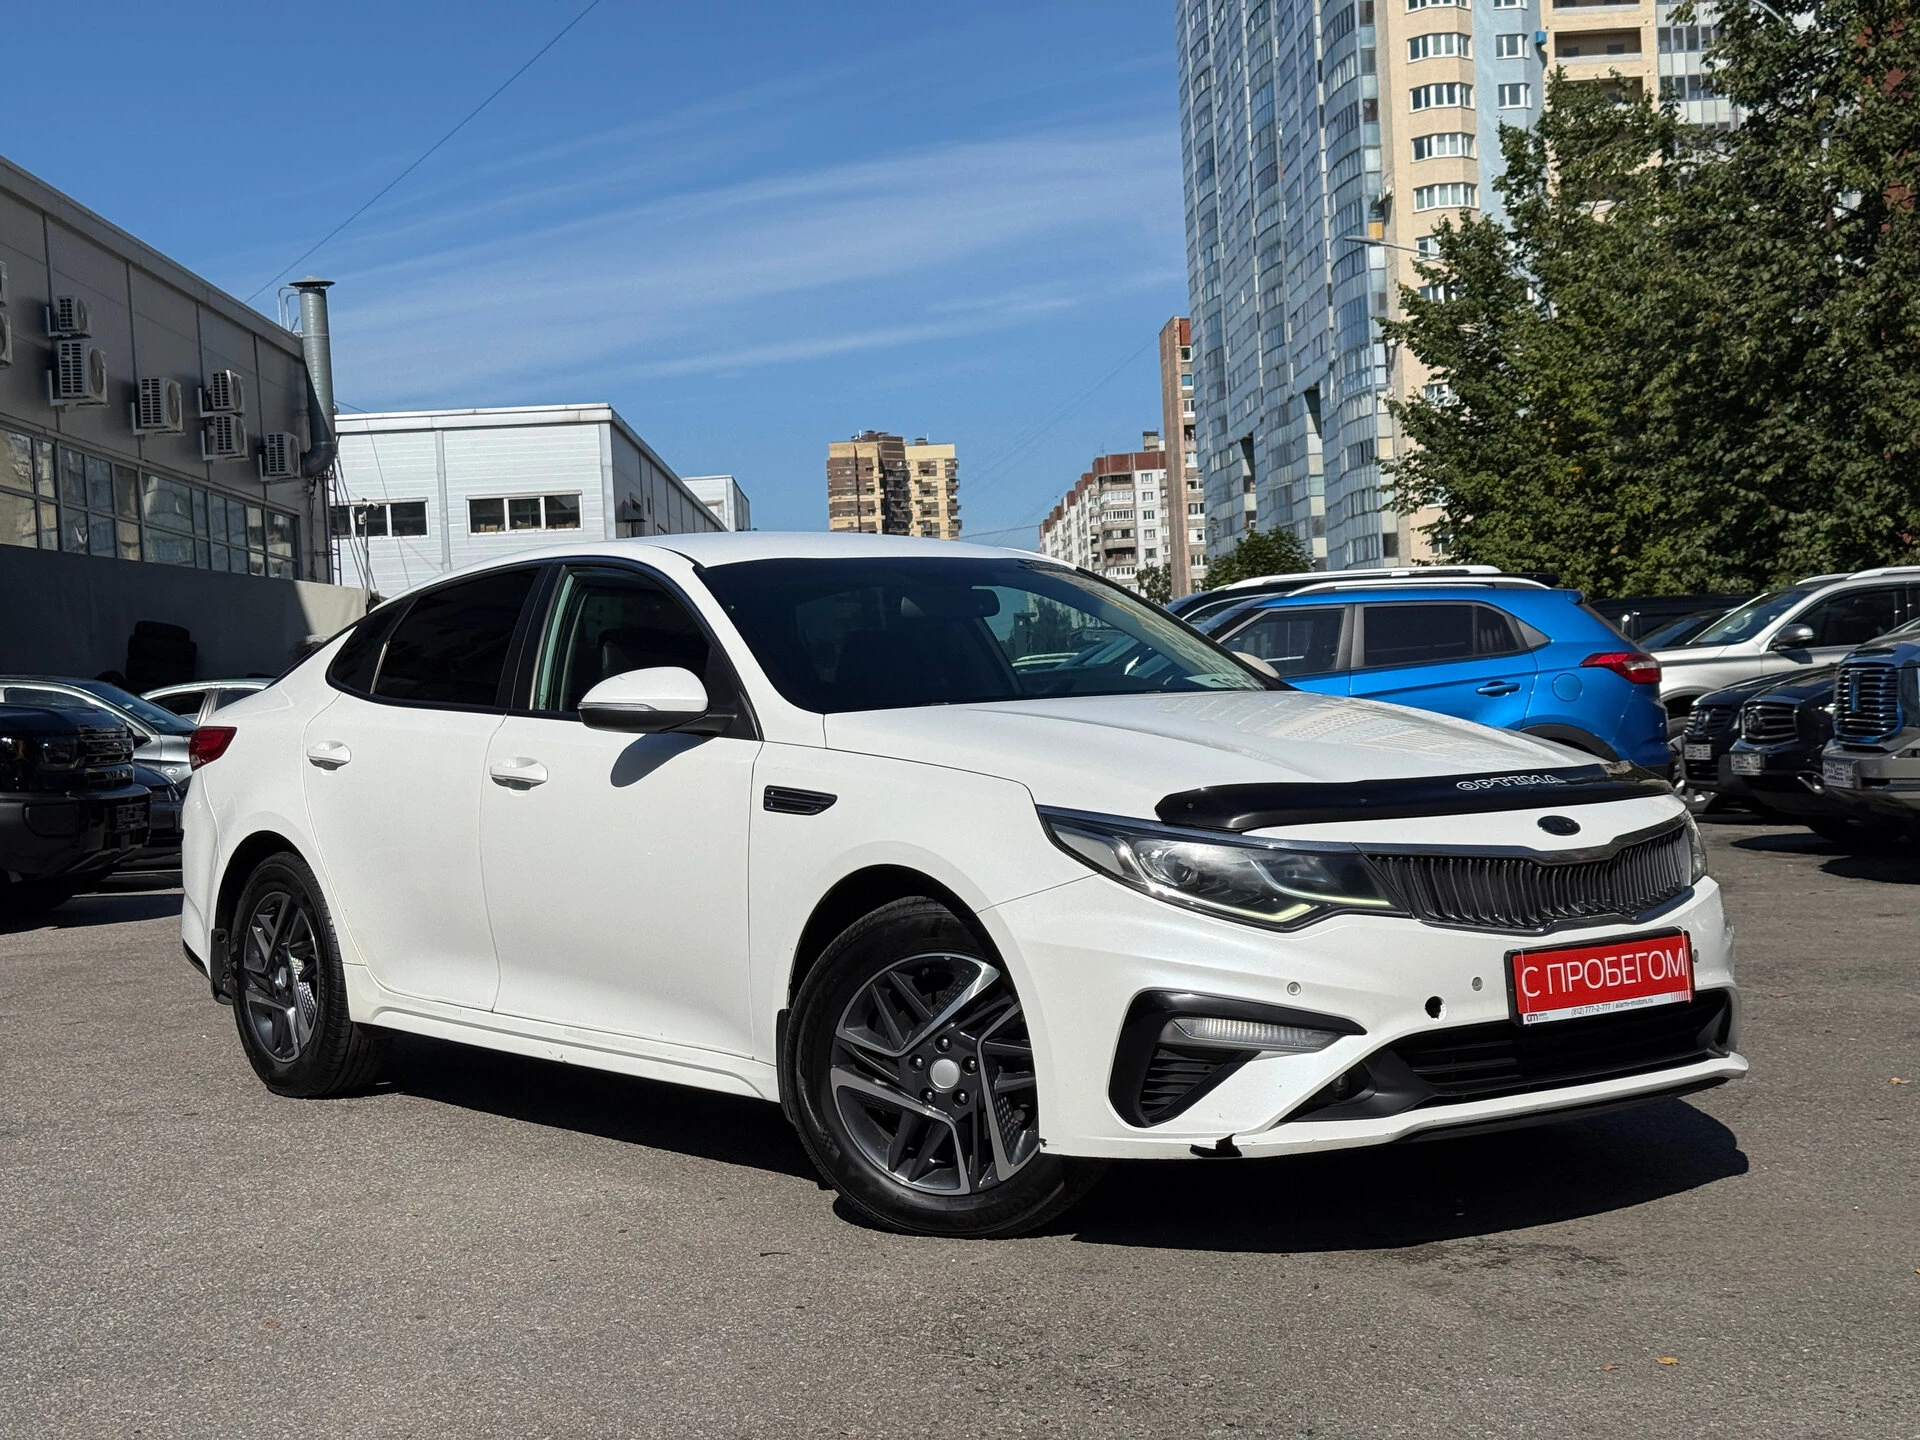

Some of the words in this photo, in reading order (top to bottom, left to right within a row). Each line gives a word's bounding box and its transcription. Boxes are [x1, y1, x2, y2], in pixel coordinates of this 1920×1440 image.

[1456, 774, 1567, 791] OPTIMA
[1521, 966, 1541, 997] С
[1546, 947, 1686, 995] ПРОБЕГОМ
[1585, 1003, 1611, 1014] 777-2-777
